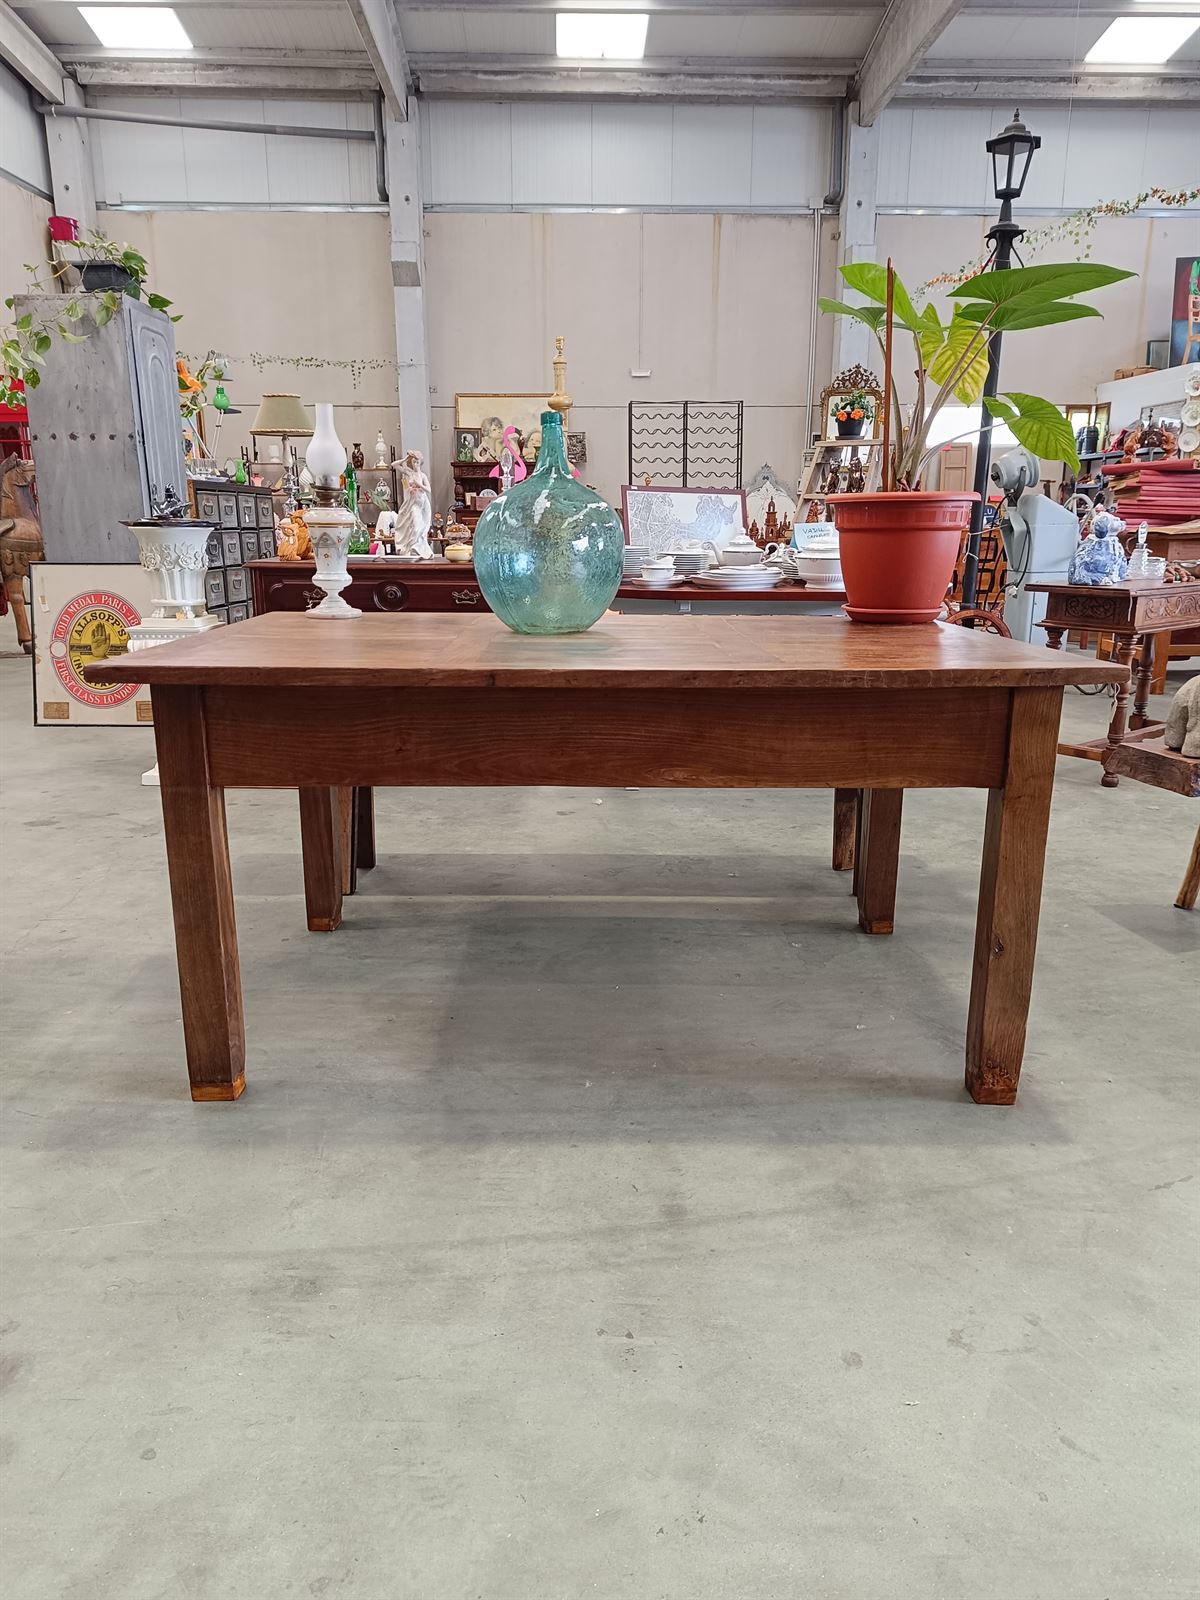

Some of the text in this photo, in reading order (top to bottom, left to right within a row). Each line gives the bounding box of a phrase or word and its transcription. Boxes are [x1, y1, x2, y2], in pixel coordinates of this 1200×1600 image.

[56, 614, 71, 639] GOLD
[67, 595, 98, 614] MEDAL
[101, 595, 128, 614] PARIS
[74, 612, 127, 637] ALLSOPP'S
[57, 662, 75, 687] FIRST
[72, 686, 100, 704] CLASS
[73, 659, 84, 676] IND
